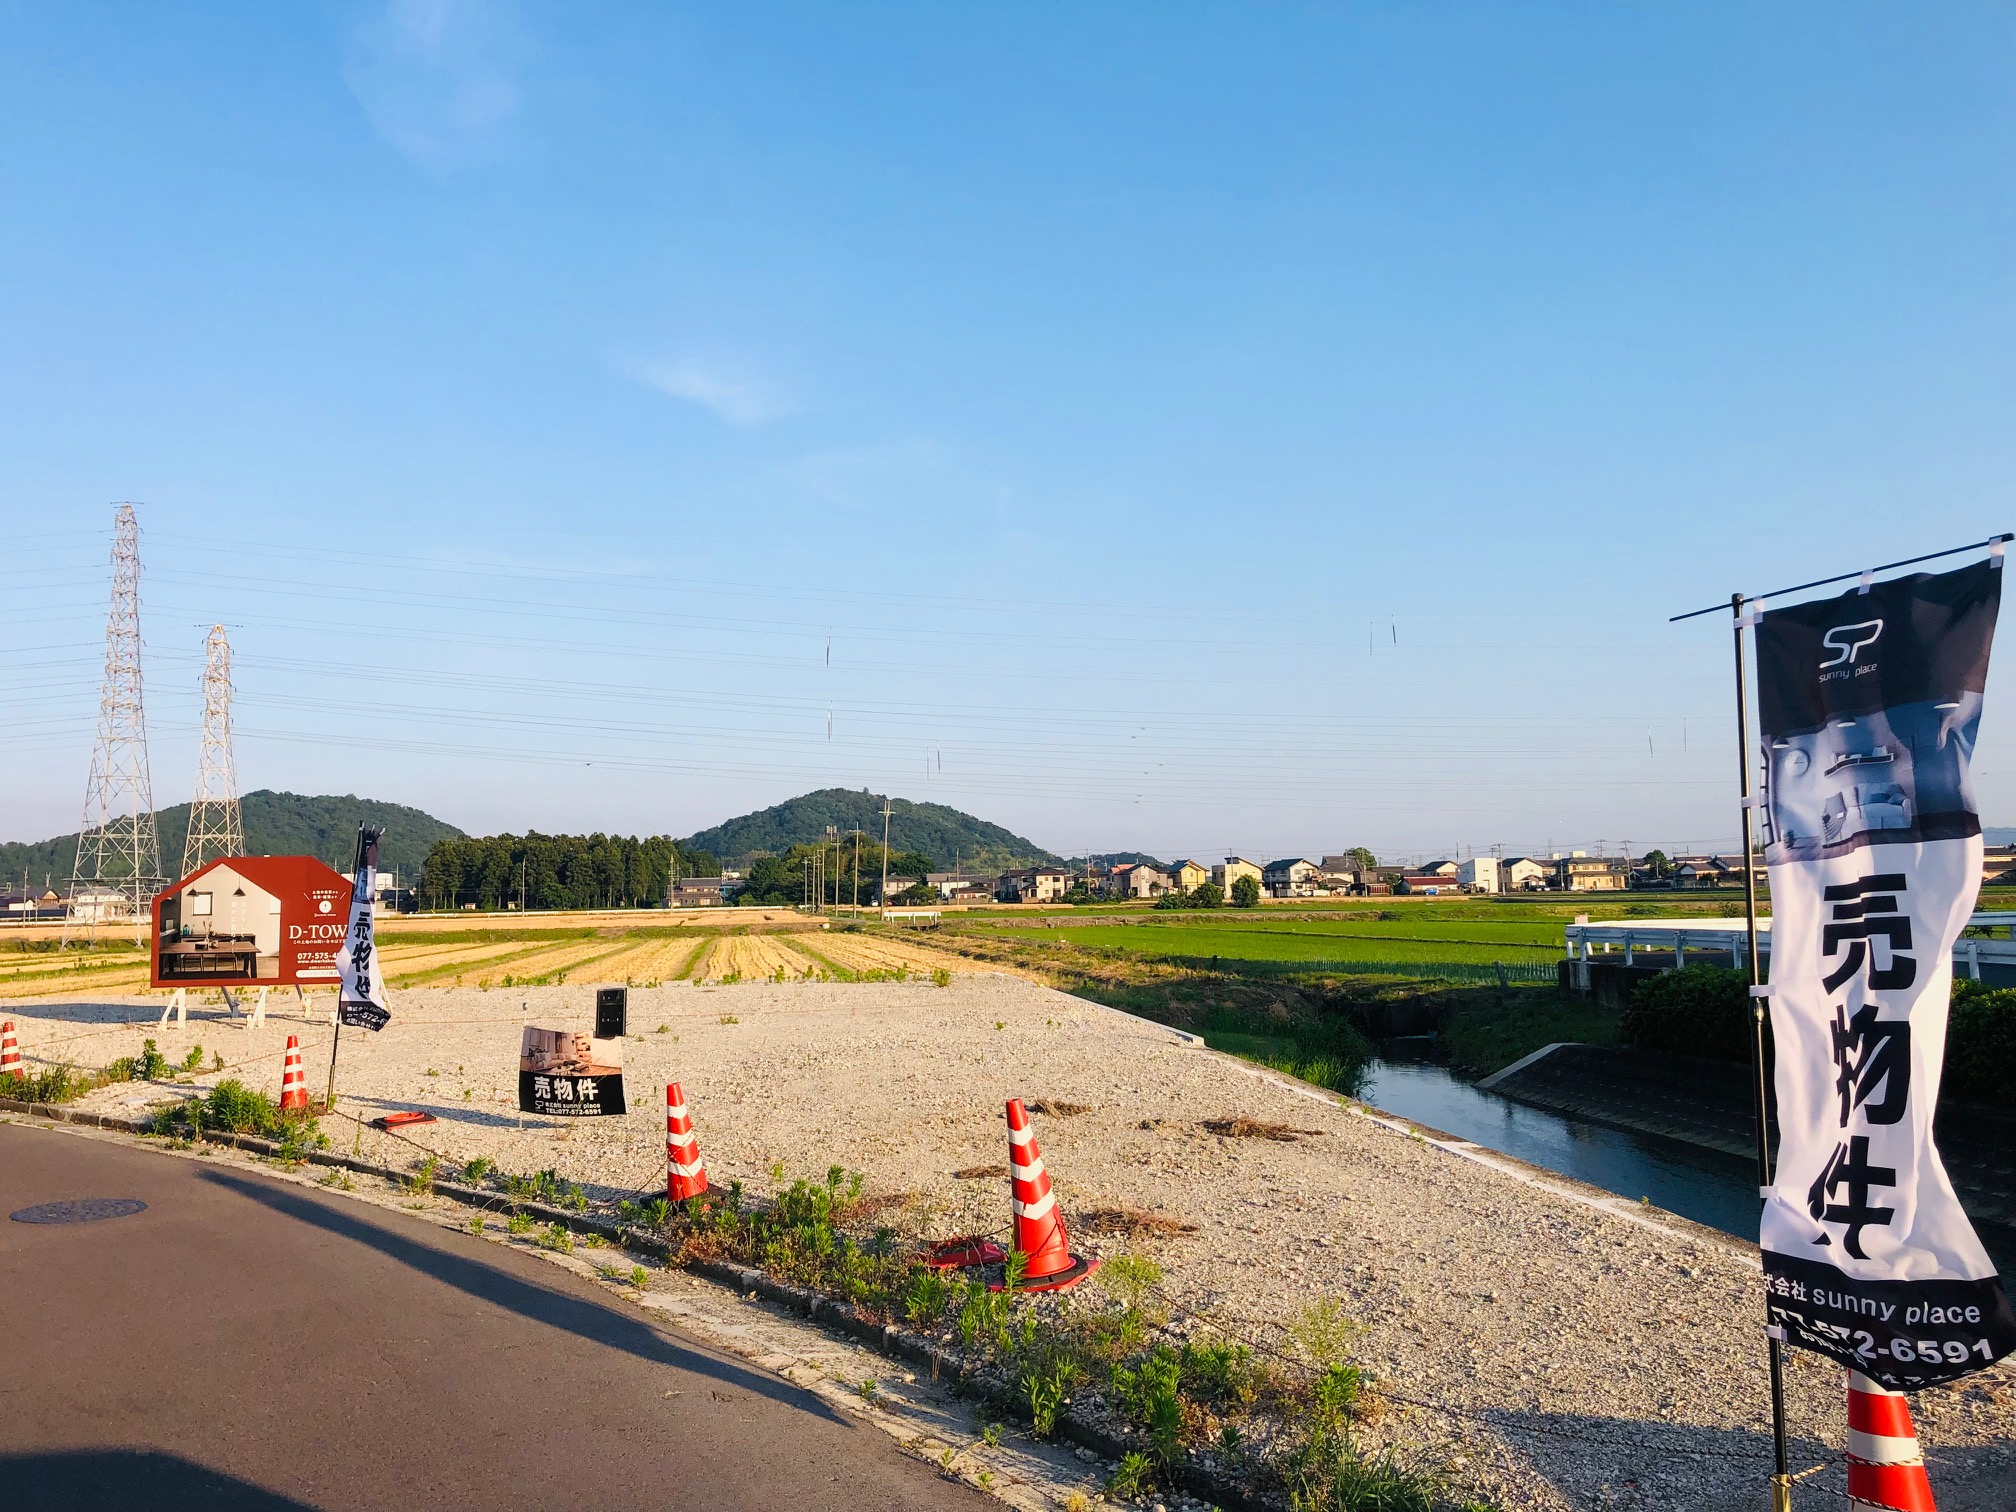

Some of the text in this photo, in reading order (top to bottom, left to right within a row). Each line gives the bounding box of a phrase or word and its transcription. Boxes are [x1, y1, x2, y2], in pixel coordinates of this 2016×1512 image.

[1819, 618, 1884, 669] SP
[1818, 662, 1878, 684] sunny place
[1806, 872, 1917, 1260] 売物件
[534, 1075, 599, 1101] 売物件
[1812, 1288, 1896, 1322] sunny
[1905, 1301, 1981, 1326] place
